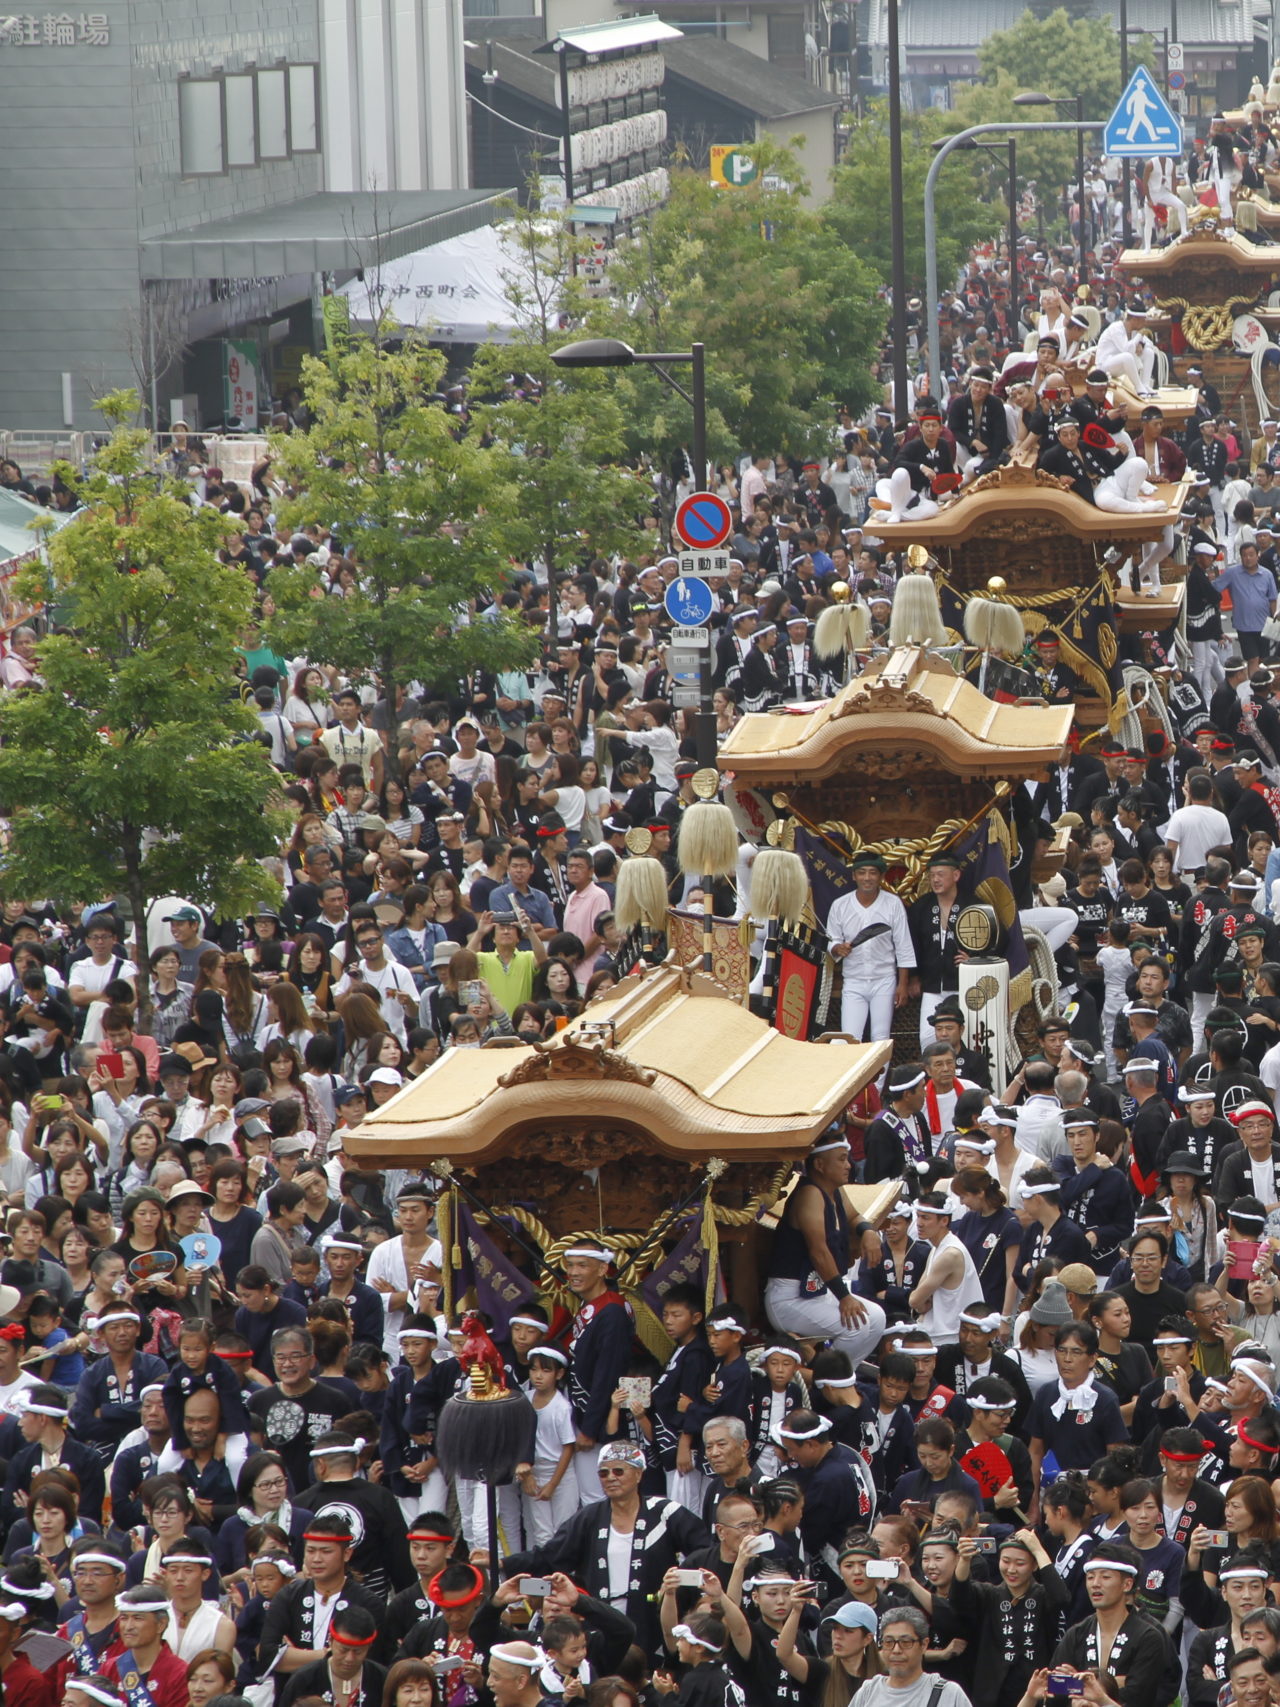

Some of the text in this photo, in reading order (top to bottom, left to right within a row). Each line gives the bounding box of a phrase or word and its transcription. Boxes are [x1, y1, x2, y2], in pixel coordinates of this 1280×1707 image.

[732, 154, 753, 183] P
[681, 557, 728, 572] 自動車
[1001, 1613, 1015, 1661] 小社之町
